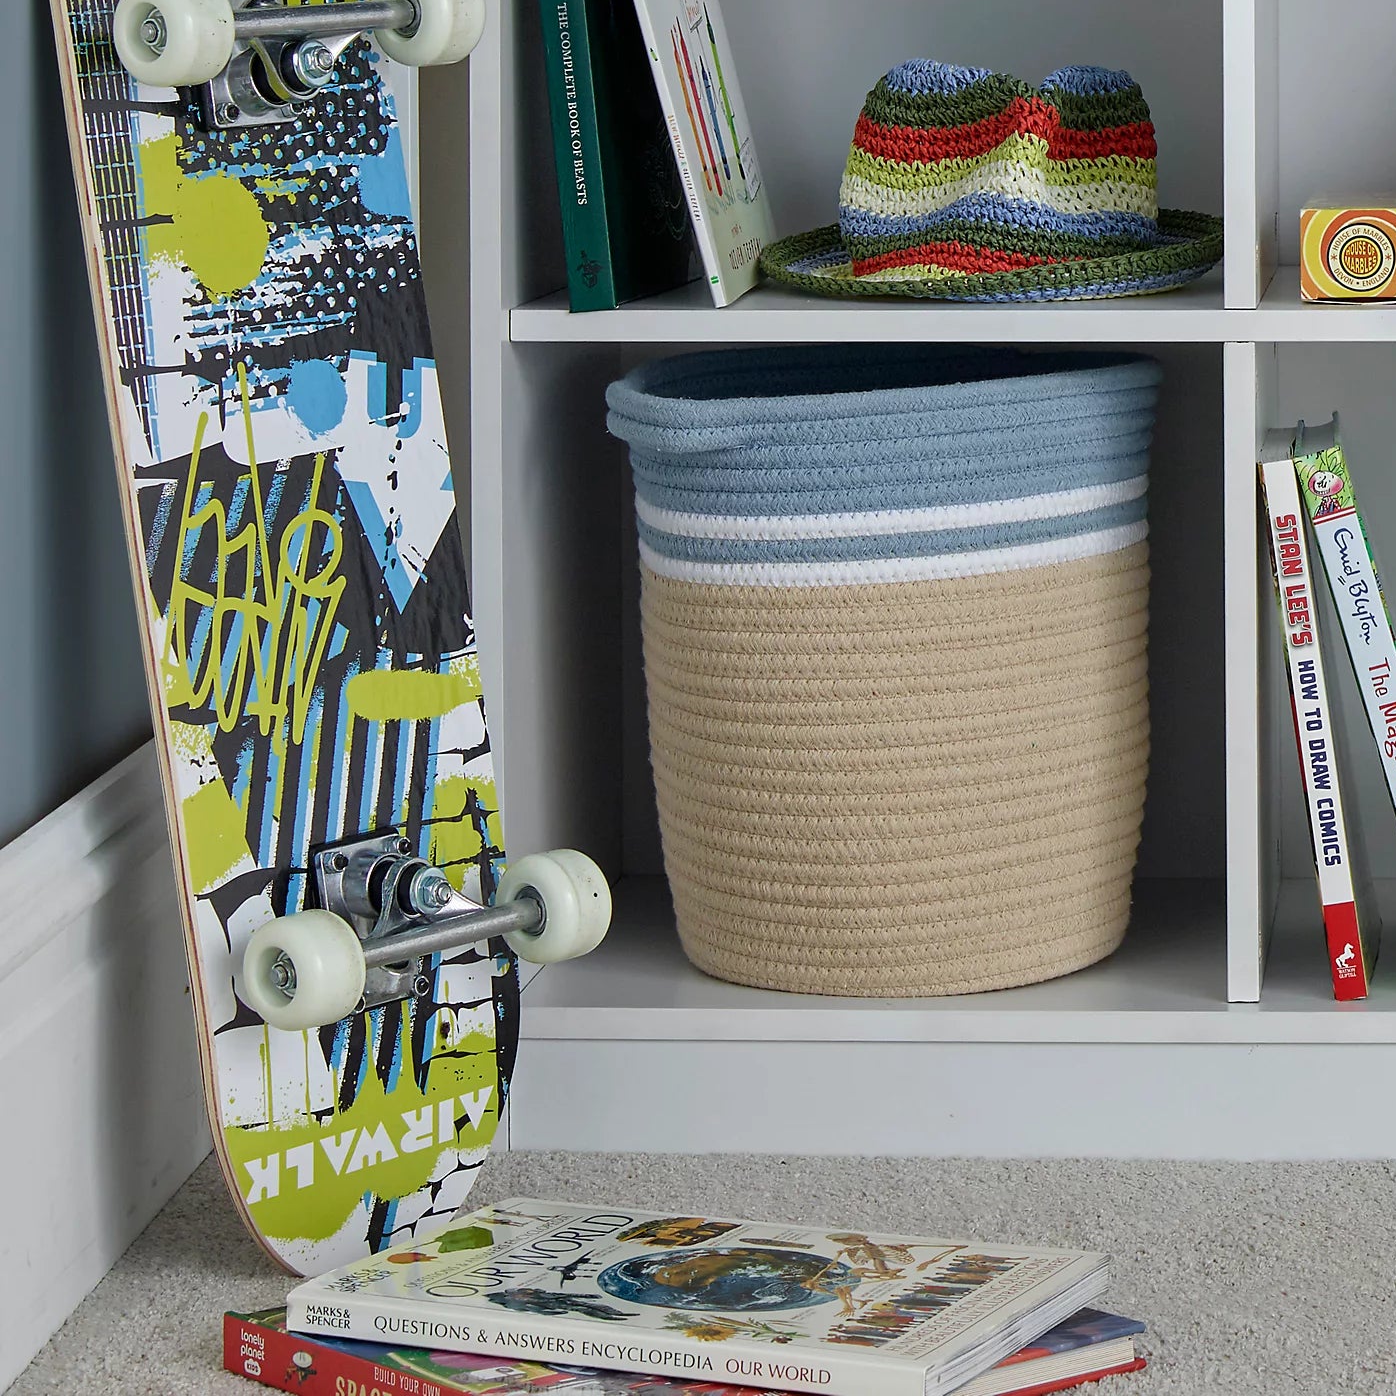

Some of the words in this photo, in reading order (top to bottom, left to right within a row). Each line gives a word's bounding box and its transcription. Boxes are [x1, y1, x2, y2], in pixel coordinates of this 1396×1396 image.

[557, 2, 569, 29] THE
[560, 31, 577, 99] COMPLETE
[568, 102, 580, 138] BOOK
[572, 140, 582, 156] OF
[574, 159, 588, 206] BEASTS
[1333, 231, 1350, 252] HOUSE
[1351, 227, 1361, 236] OF
[1363, 228, 1390, 252] MARBLES
[1345, 240, 1367, 255] HOUSE
[1367, 241, 1376, 255] OF
[1333, 268, 1354, 285] DEVON
[1362, 266, 1390, 287] ENGLAND
[1344, 255, 1377, 274] MARBLES
[1275, 514, 1303, 576] STAN
[1285, 584, 1313, 646] LEE'S
[1333, 528, 1361, 577] Enid
[1349, 579, 1378, 646] Blyton
[1368, 657, 1391, 698] The
[1298, 660, 1319, 700] HOW
[1304, 708, 1323, 731] TO
[1308, 739, 1331, 790] DRAW
[1317, 797, 1342, 867] COMICS
[243, 1085, 494, 1203] AIRWALK
[426, 1267, 527, 1297] OUR
[494, 1214, 634, 1265] WORLD
[306, 1315, 350, 1329] SPENCER
[240, 1328, 265, 1350] lonely
[240, 1344, 265, 1361] planet
[374, 1316, 470, 1341] QUESTIONS
[477, 1329, 489, 1343] &
[495, 1331, 575, 1354] ANSWERS
[582, 1341, 713, 1371] ENCYCLOPEDIA
[374, 1367, 396, 1386] BUILD
[399, 1375, 419, 1394] YOUR
[423, 1383, 441, 1396] OWN
[726, 1358, 763, 1377] OUR
[768, 1363, 831, 1385] WORLD
